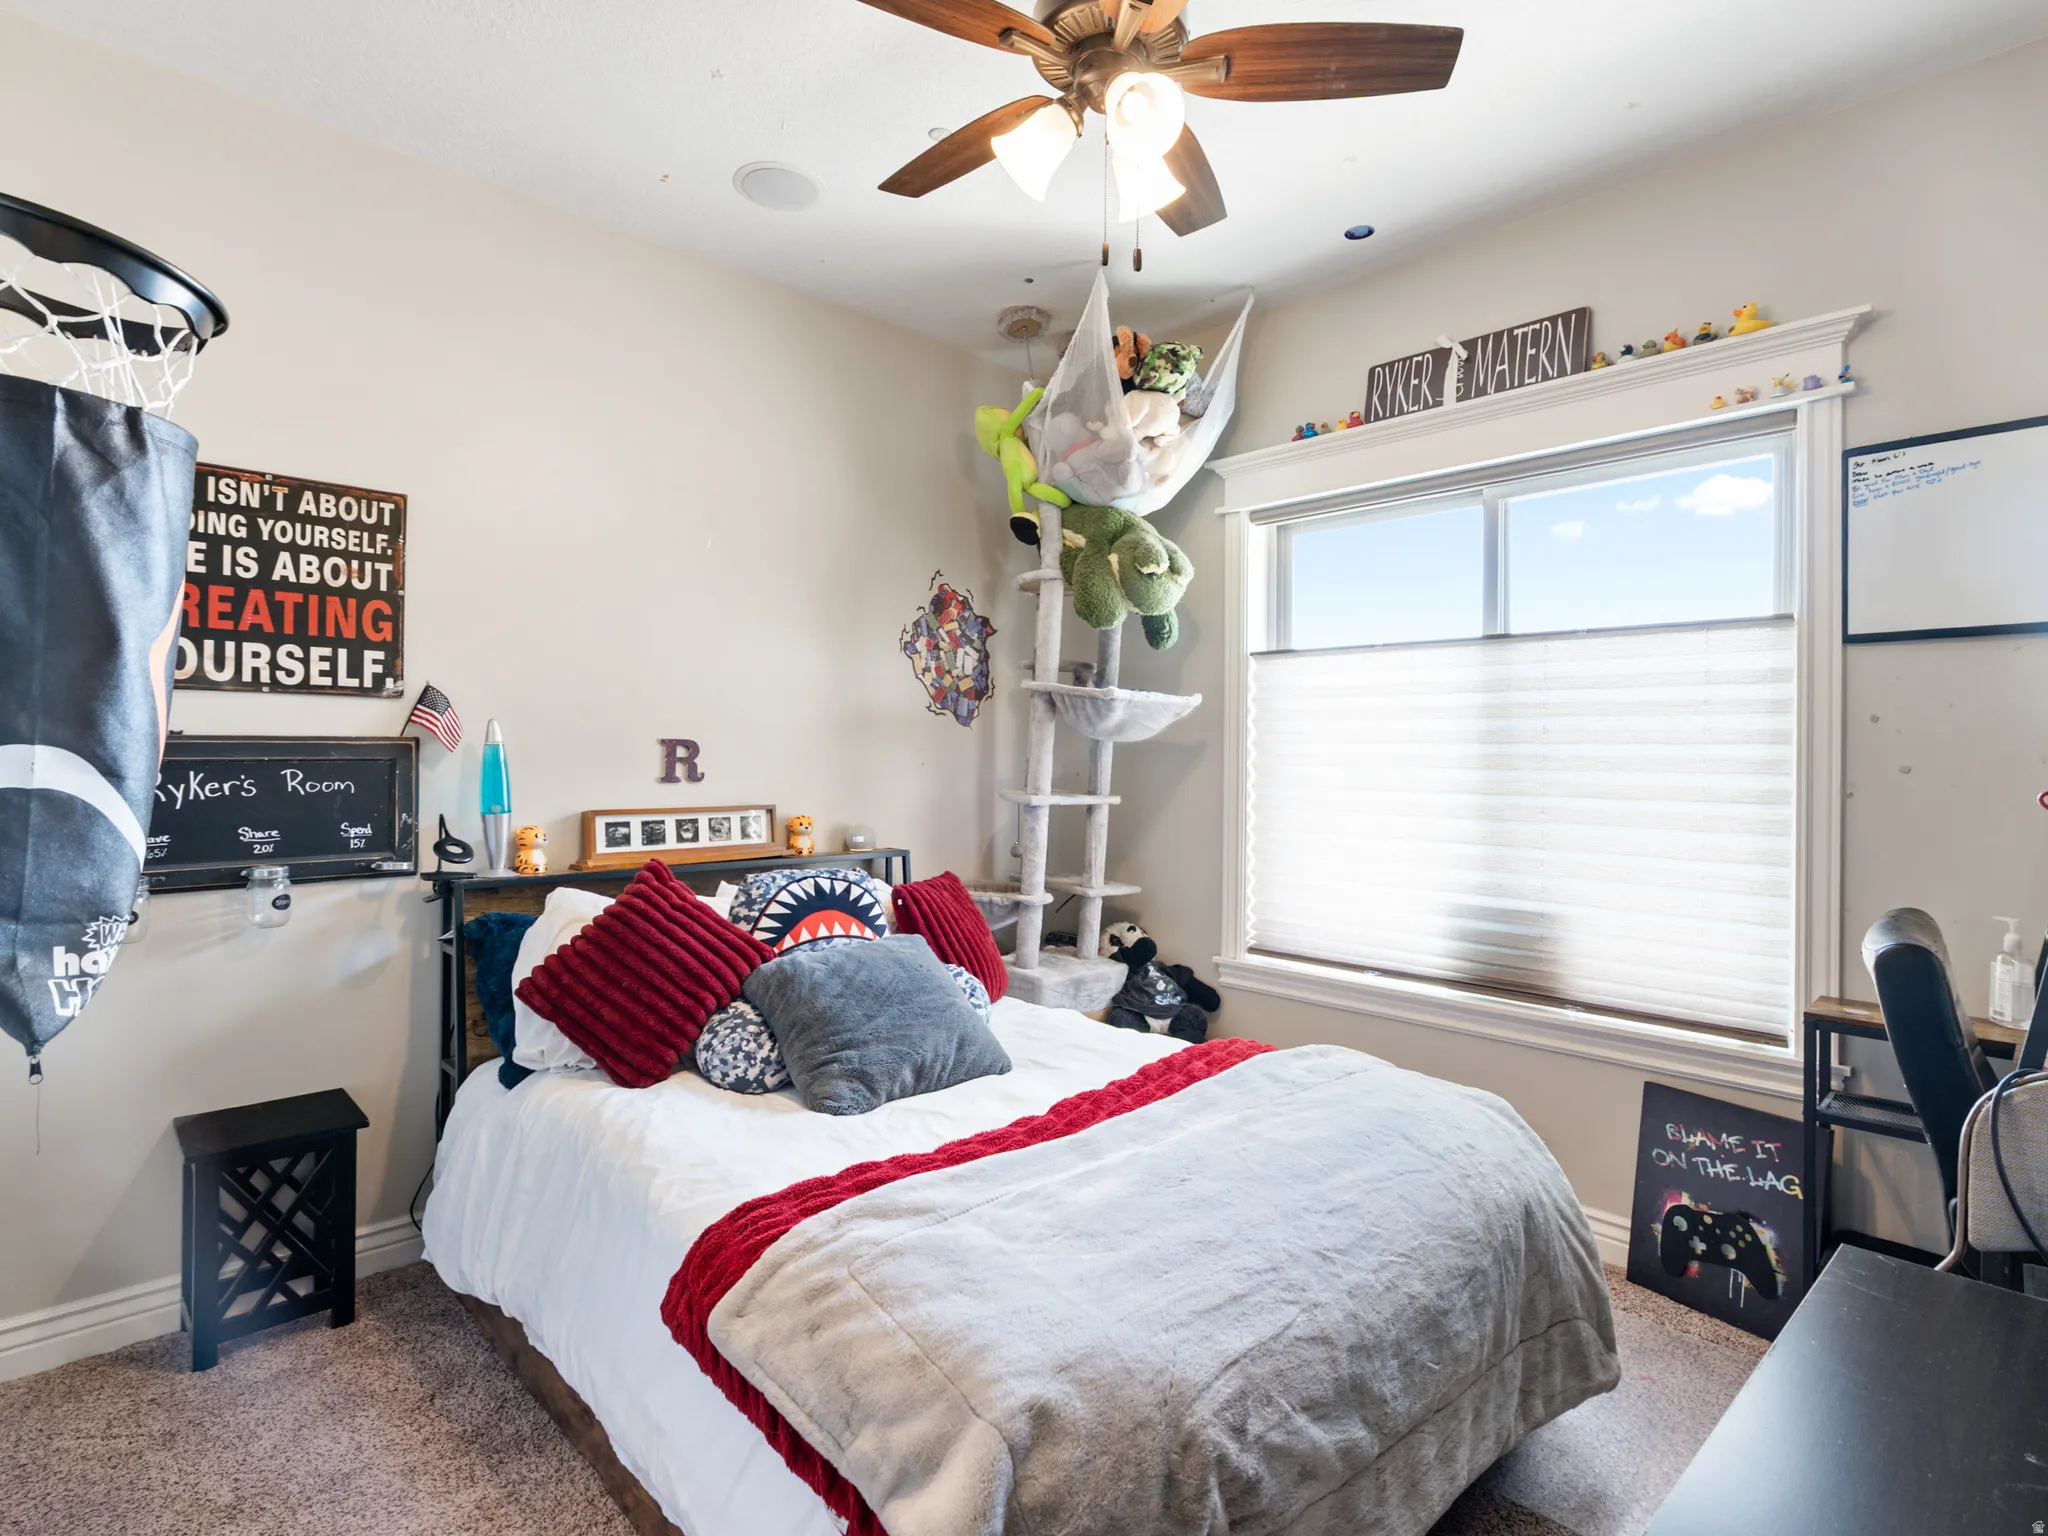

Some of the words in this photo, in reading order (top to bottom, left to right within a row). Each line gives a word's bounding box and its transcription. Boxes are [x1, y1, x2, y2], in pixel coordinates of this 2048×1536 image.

[1371, 354, 1433, 421] RYKER
[1471, 314, 1575, 398] MATERN
[207, 476, 289, 511] ISN'T
[298, 490, 395, 526] ABOUT
[189, 509, 248, 539] ING
[256, 517, 393, 556] YOURSELF.
[222, 545, 259, 579] IS
[272, 551, 393, 592] ABOUT
[280, 769, 354, 795] Room
[658, 738, 705, 783] R
[237, 827, 281, 840] Share
[341, 822, 372, 837] Spend
[253, 843, 274, 854] 20%
[350, 838, 366, 848] 15%
[1665, 1123, 1746, 1153] BLAME
[1751, 1139, 1782, 1162] IT
[1652, 1148, 1688, 1169] ON
[1692, 1156, 1741, 1182] THE
[1747, 1166, 1804, 1200] LAG
